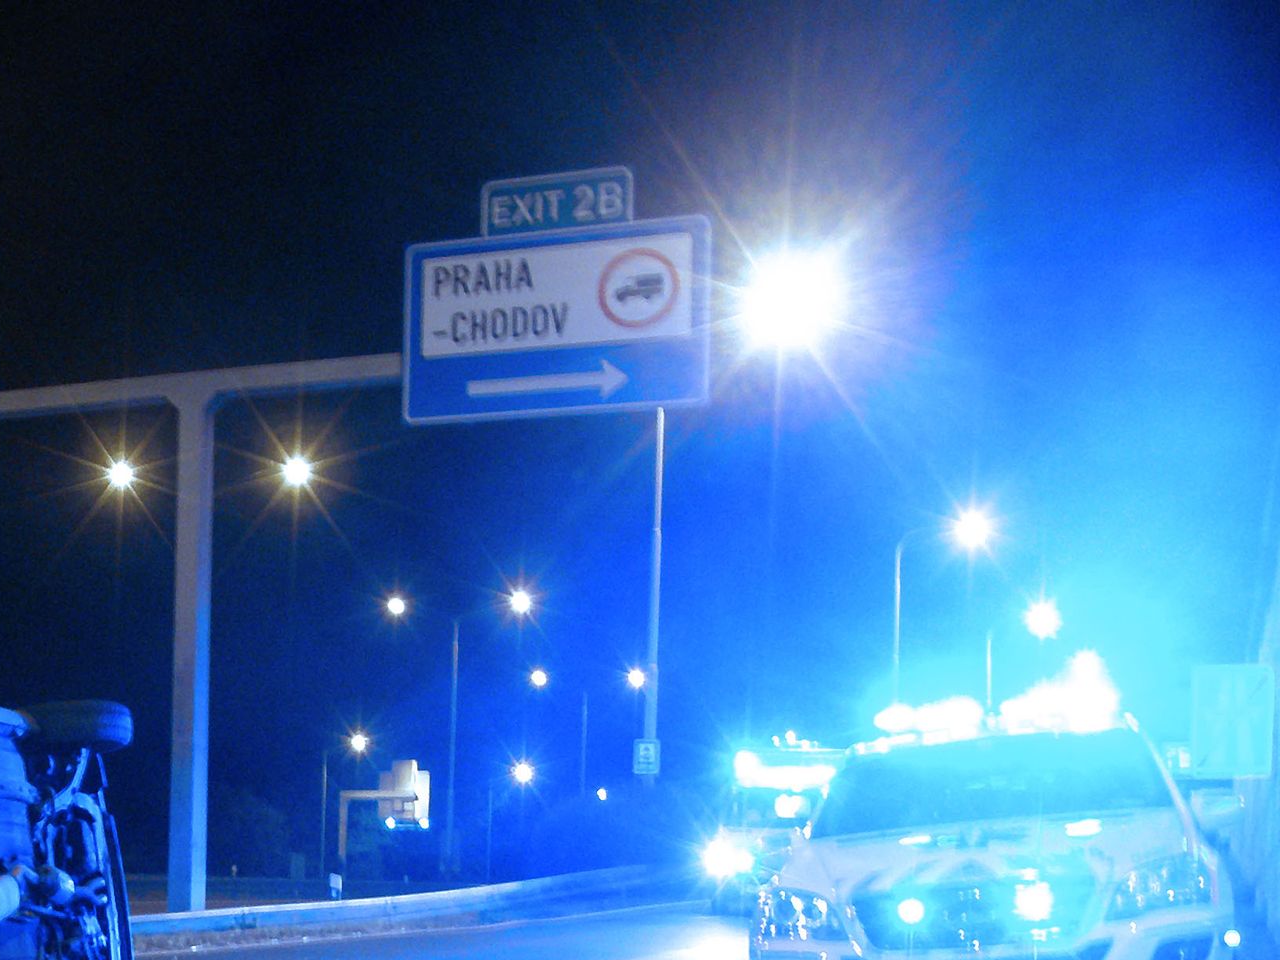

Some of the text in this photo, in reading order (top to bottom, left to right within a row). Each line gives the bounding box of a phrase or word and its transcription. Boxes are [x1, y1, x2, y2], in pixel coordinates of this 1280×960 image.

[492, 181, 623, 228] EXIT 2B
[432, 257, 534, 298] PRAHA
[433, 302, 568, 344] -CHODOV
